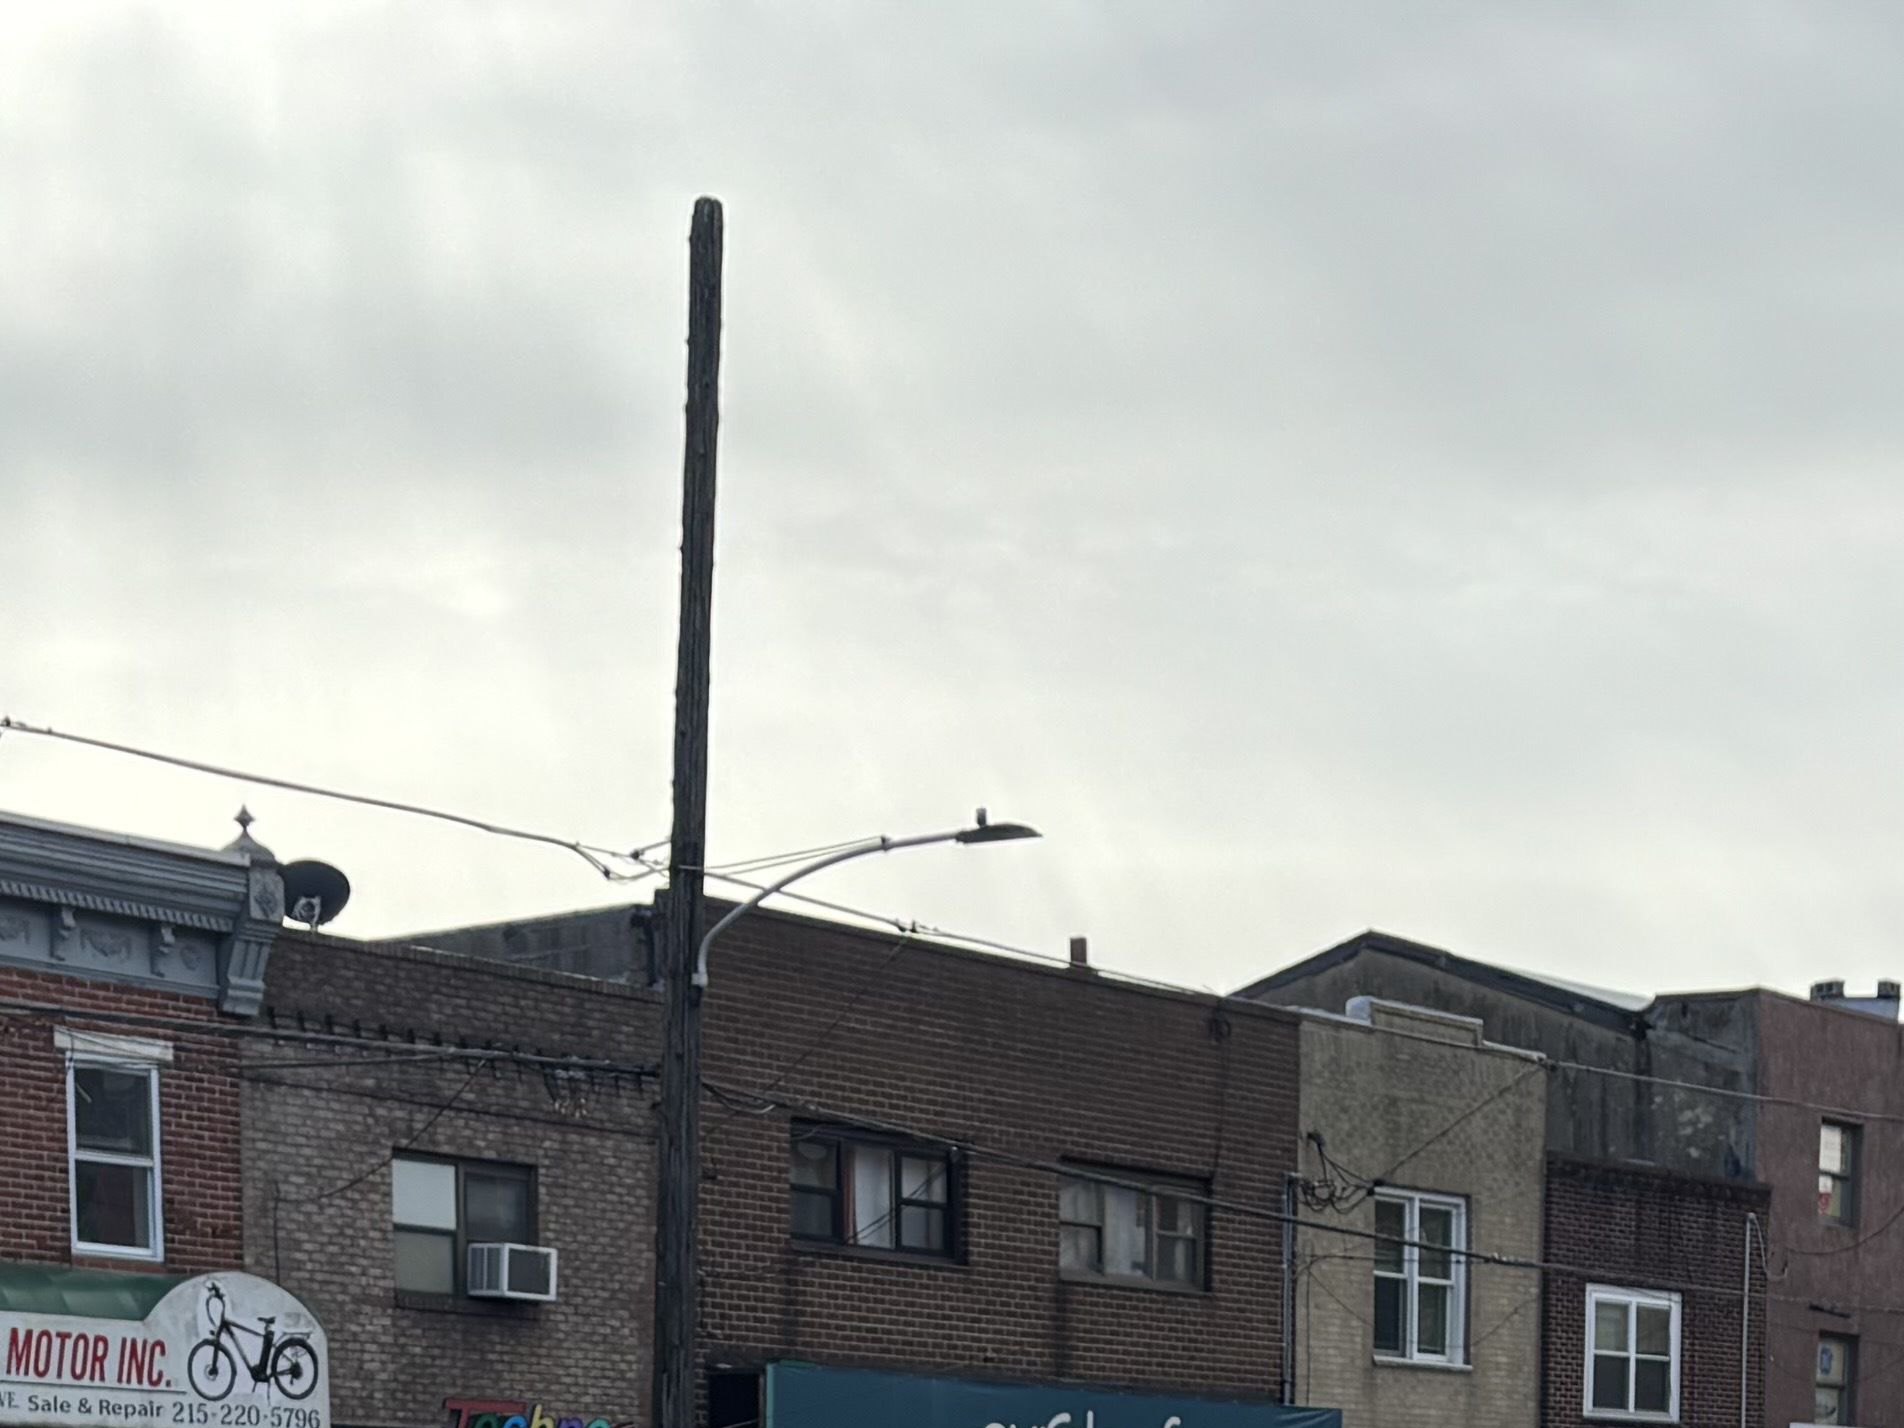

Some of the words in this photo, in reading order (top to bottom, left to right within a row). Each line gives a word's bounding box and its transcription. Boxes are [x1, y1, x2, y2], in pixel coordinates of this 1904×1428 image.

[6, 1327, 109, 1384] MOTOR
[116, 1336, 172, 1388] INC.
[27, 1395, 72, 1414] Sale
[78, 1398, 93, 1414] &
[98, 1398, 164, 1421] Repair
